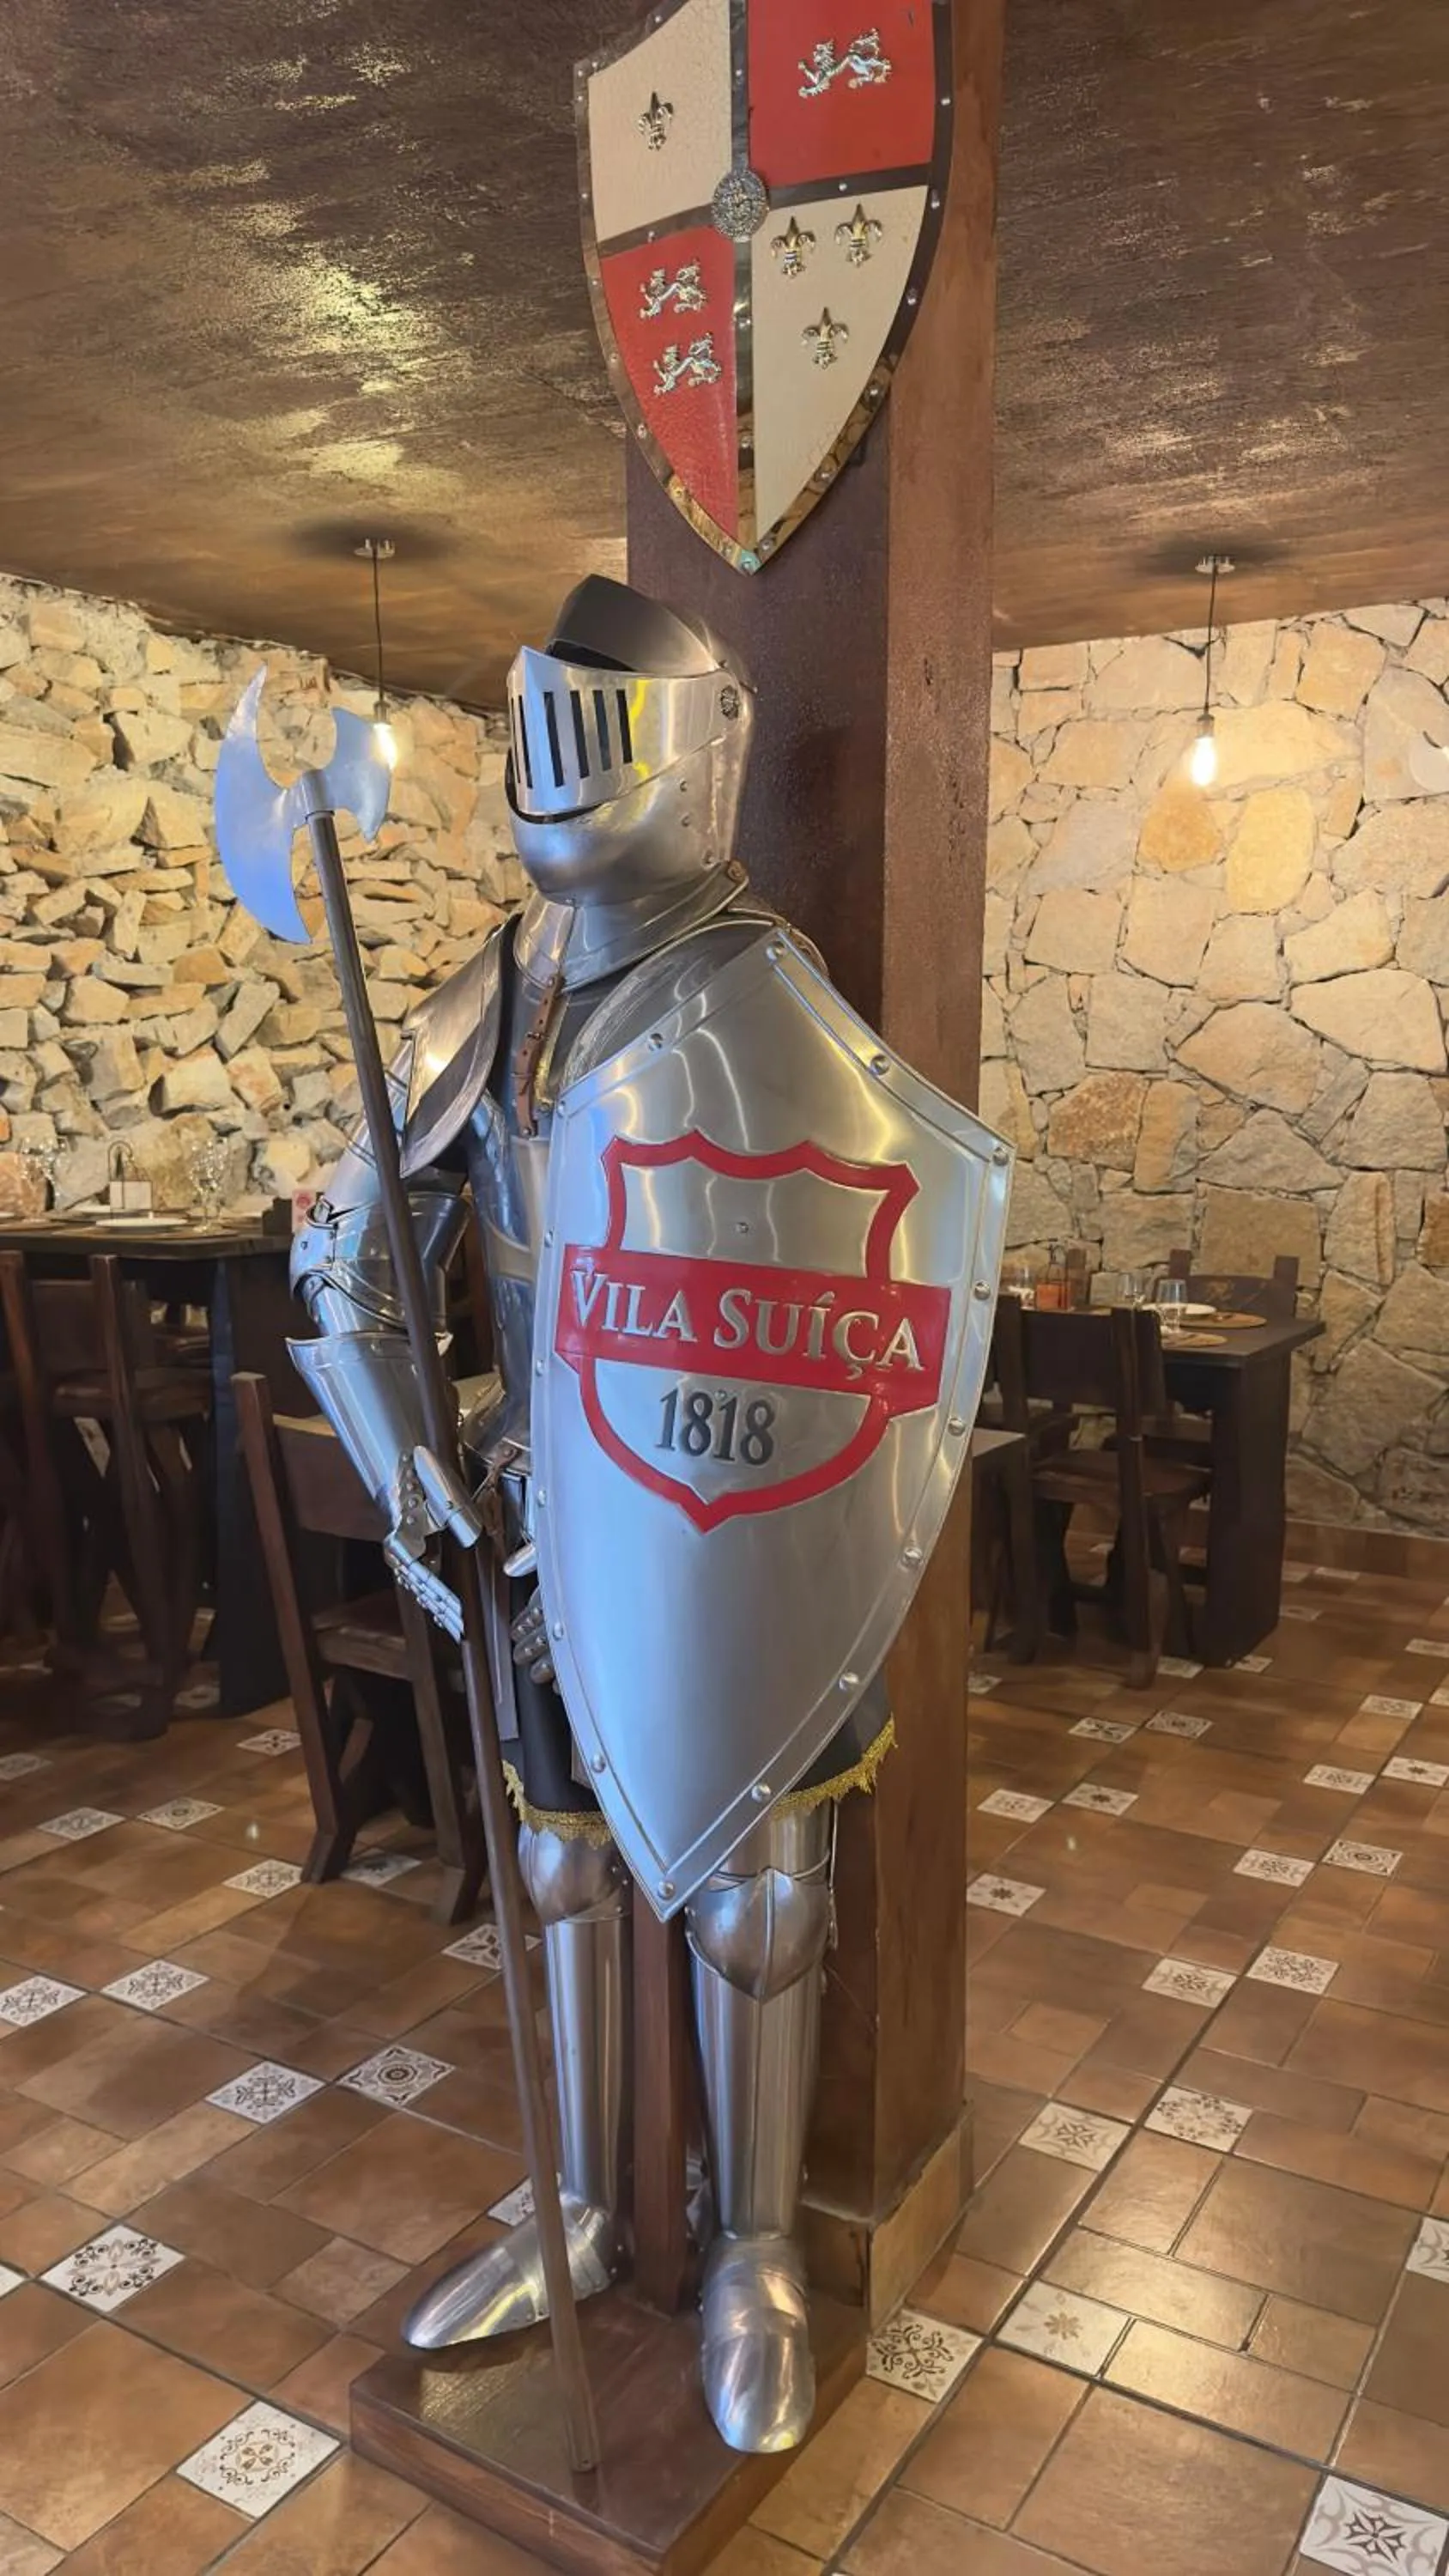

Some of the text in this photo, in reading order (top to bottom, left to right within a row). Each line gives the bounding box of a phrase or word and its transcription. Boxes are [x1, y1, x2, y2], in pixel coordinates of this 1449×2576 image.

[572, 1272, 924, 1379] VILA SUÍÇA
[655, 1388, 774, 1466] 1818
